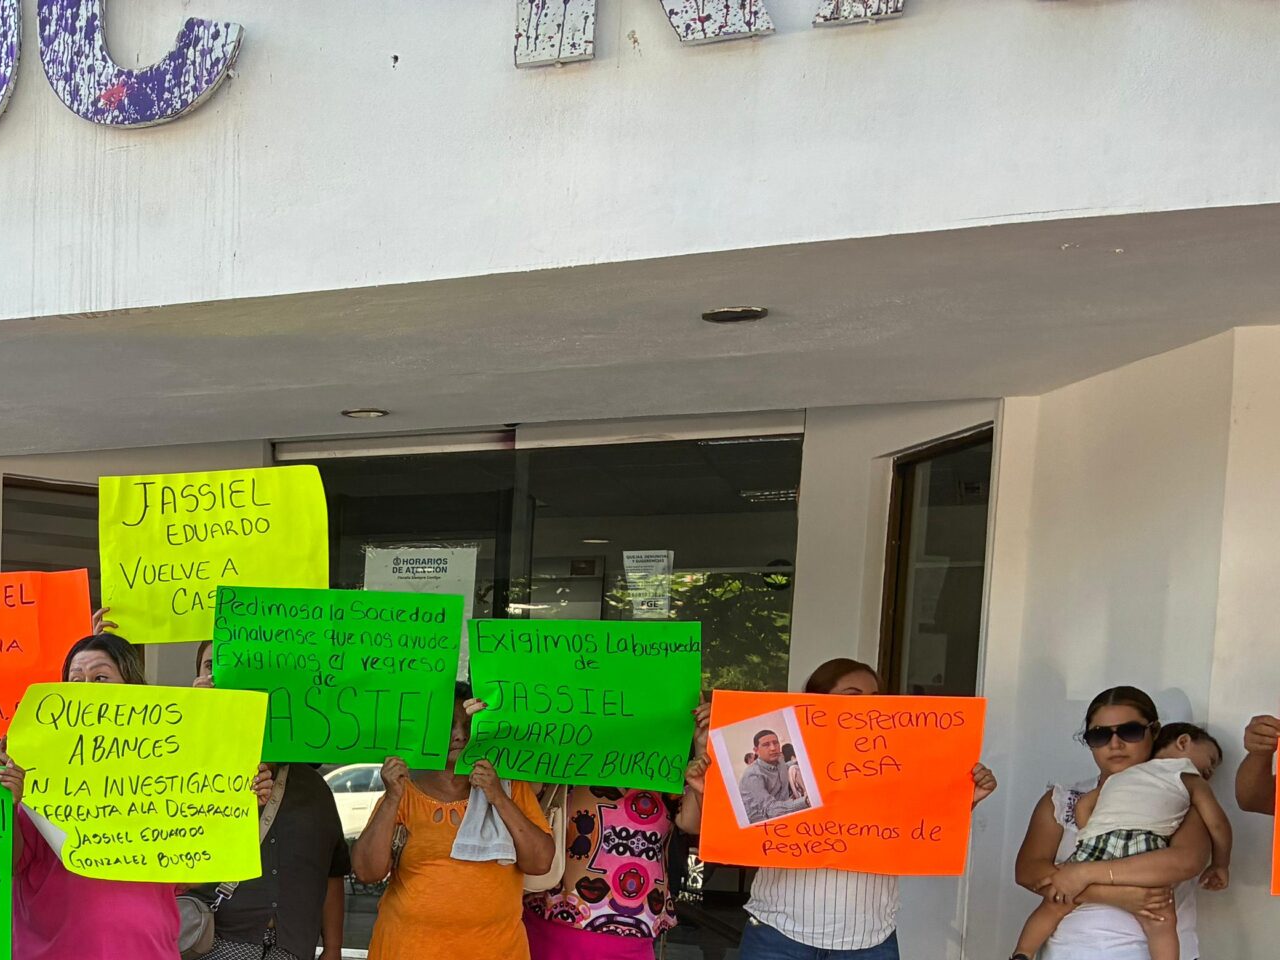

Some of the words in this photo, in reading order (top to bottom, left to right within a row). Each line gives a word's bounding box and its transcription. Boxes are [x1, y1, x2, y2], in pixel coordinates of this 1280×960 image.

[122, 478, 270, 527] JASSIEL
[166, 517, 270, 546] EDUARDO
[119, 556, 210, 589] VUELVE
[221, 558, 238, 577] A
[330, 604, 344, 621] la
[574, 655, 600, 670] de
[312, 670, 338, 687] de
[35, 693, 183, 731] QUEREMOS
[485, 680, 634, 717] JASSIEL
[795, 704, 828, 728] Te
[837, 709, 965, 731] esperamos
[476, 720, 593, 746] EDUARDO
[854, 734, 888, 753] en
[68, 734, 180, 766] ABANCES
[599, 751, 684, 784] BURGOS
[826, 755, 902, 782] CASA
[70, 826, 133, 849] JASSIEL
[910, 818, 942, 843] de
